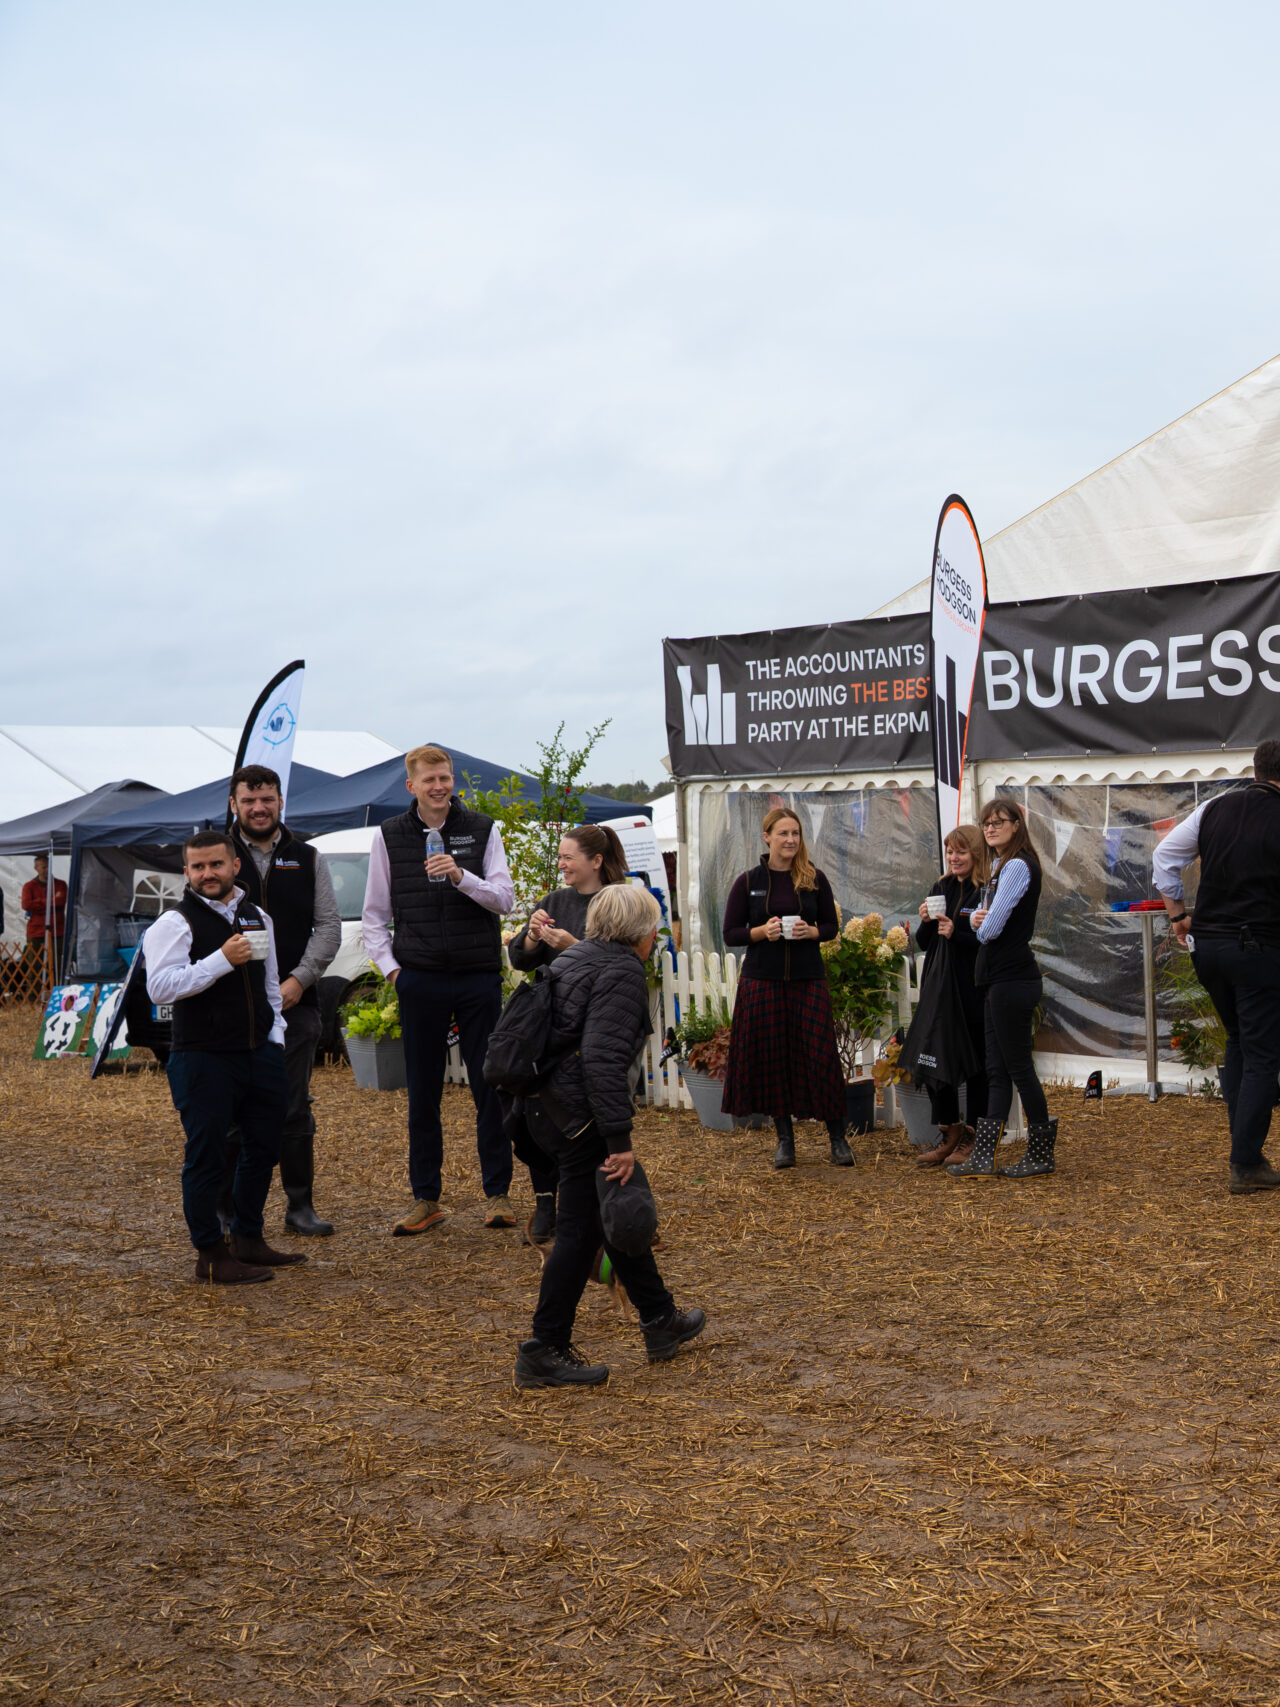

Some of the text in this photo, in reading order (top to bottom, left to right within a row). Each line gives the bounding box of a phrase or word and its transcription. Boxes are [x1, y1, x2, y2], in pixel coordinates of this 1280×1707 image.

[745, 643, 925, 681] THE ACCOUNTANTS
[747, 676, 931, 712] THROWING THE BES
[748, 710, 930, 744] PARTY AT THE EKPM
